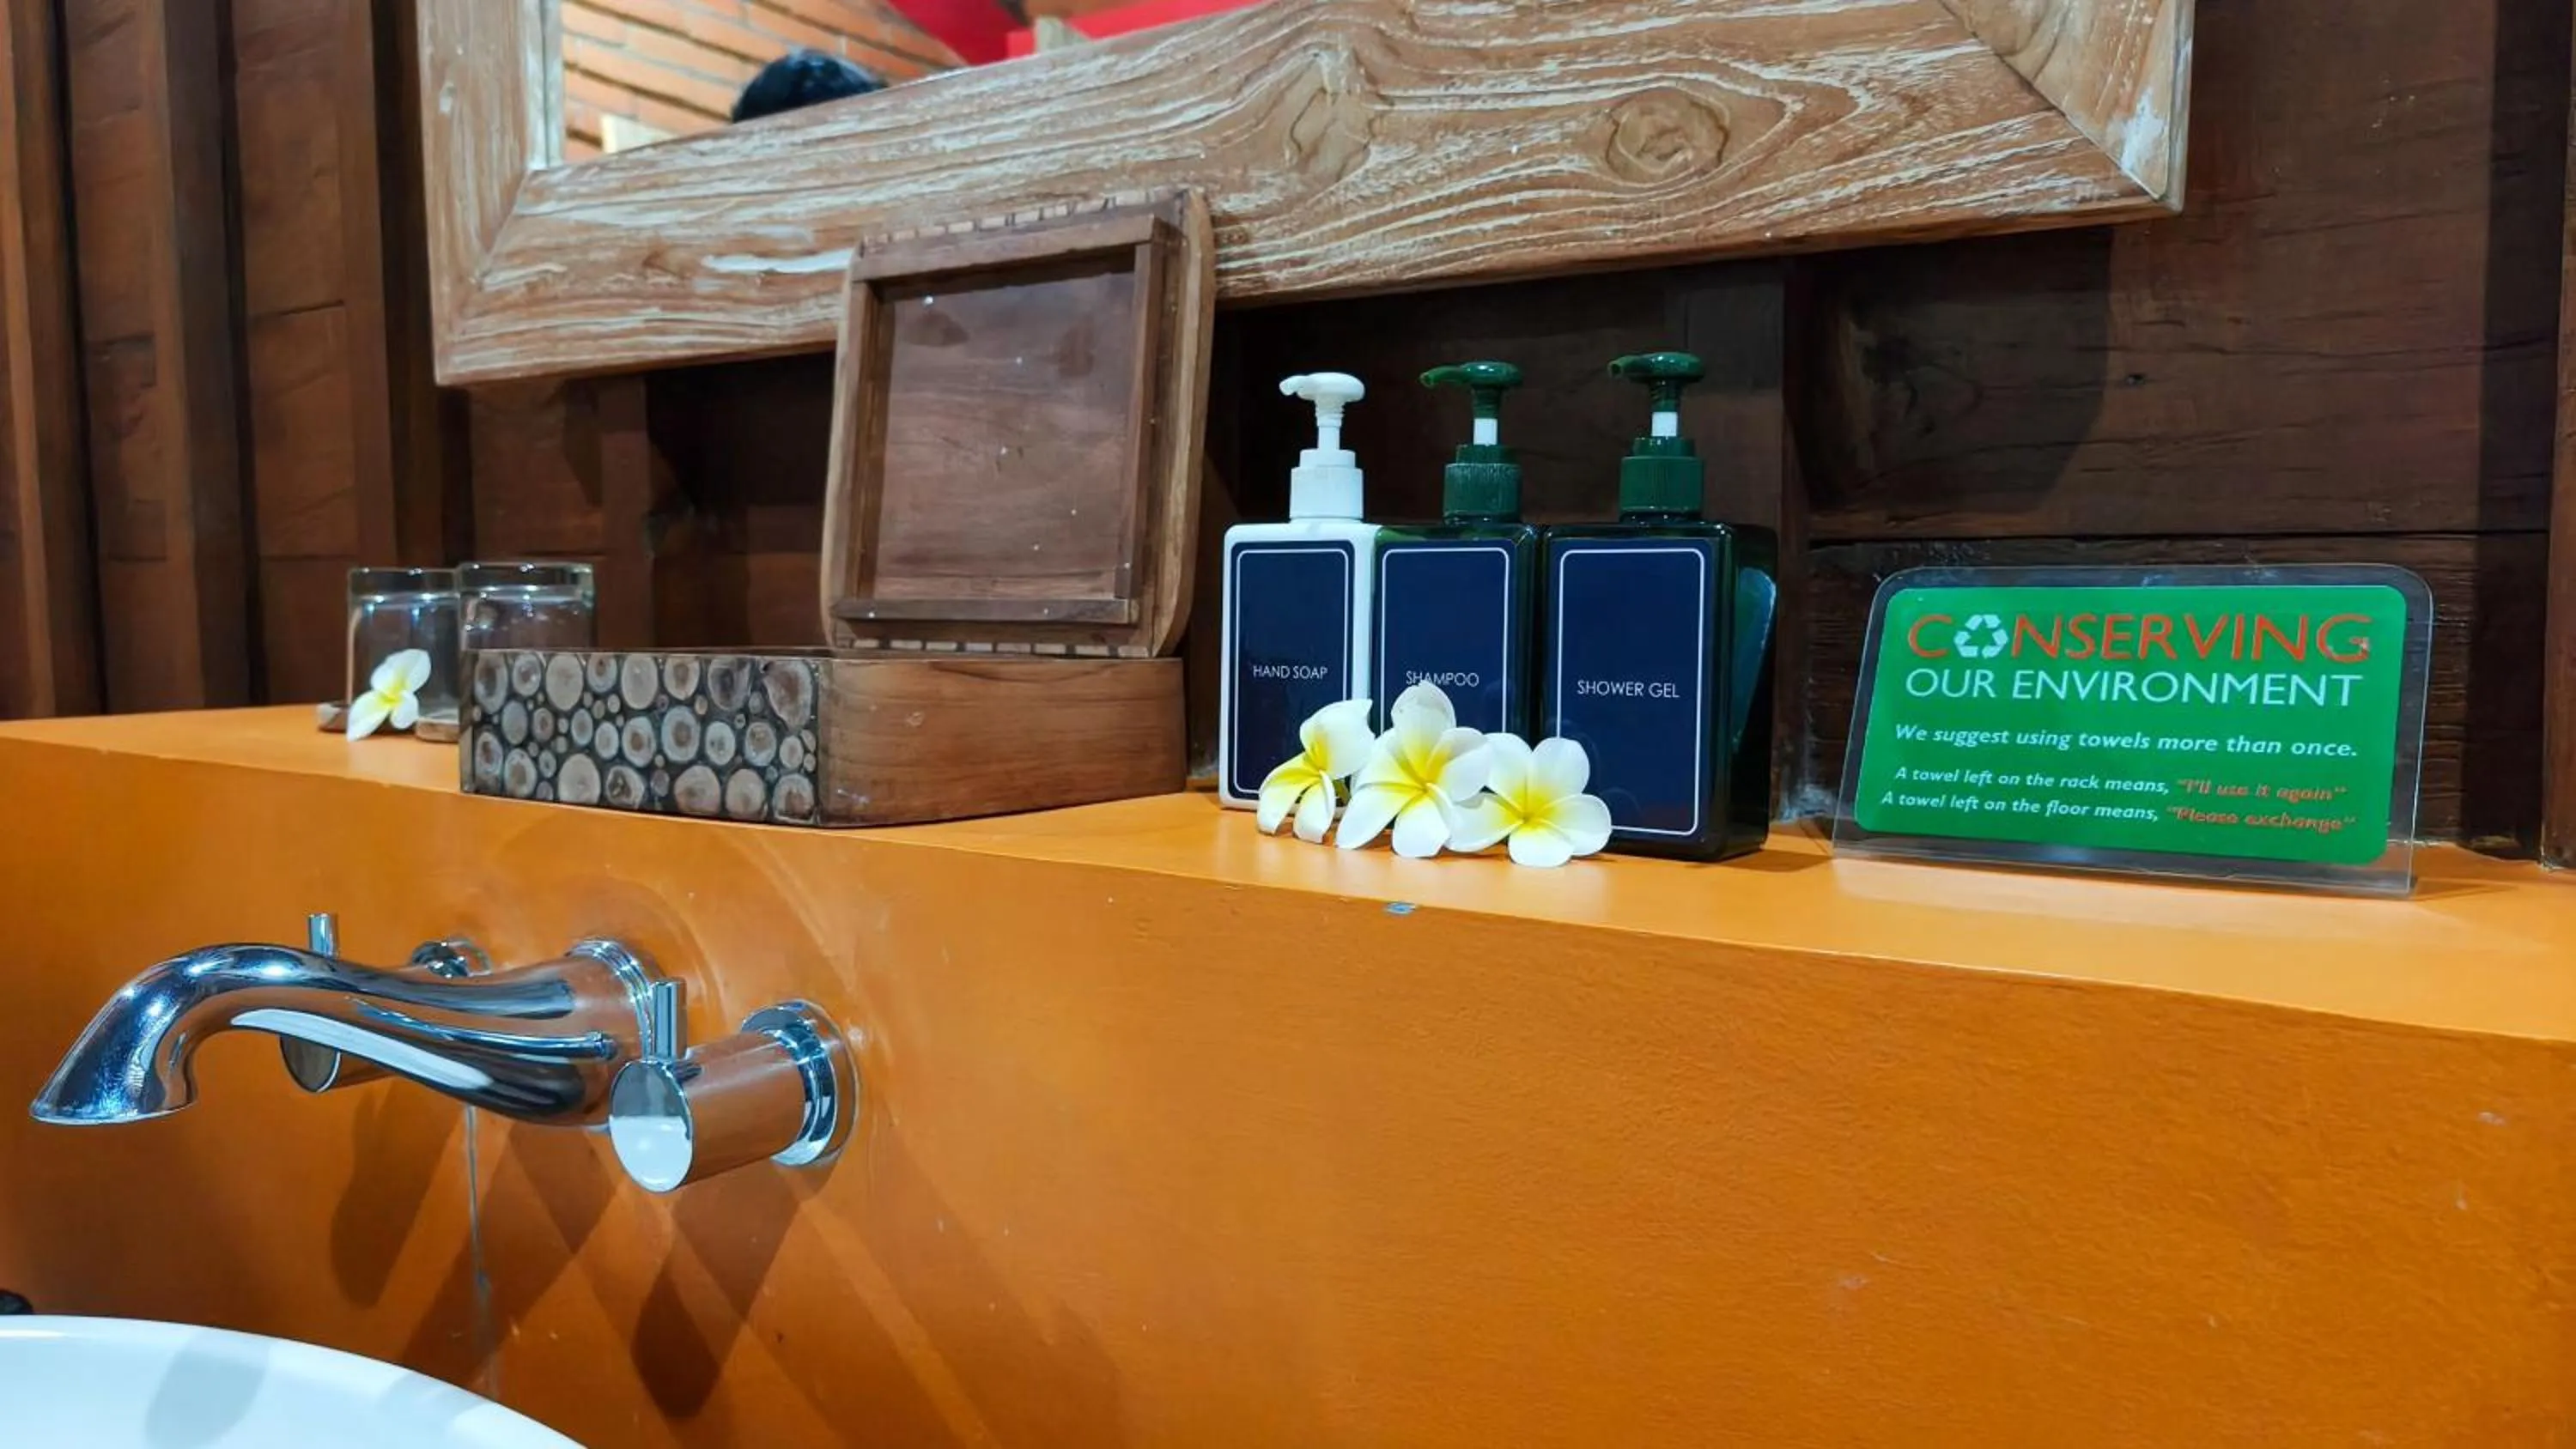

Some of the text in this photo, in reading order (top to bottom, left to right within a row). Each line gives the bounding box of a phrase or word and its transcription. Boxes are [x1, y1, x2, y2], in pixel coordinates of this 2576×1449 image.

[1906, 613, 2374, 664] CONSERVING
[1253, 665, 1328, 680] HAND SOAP
[1406, 670, 1479, 687] SHAMPOO
[1905, 668, 2365, 707] OUR ENVIRONMENT
[1577, 679, 1680, 699] SHOWER GEL
[1895, 724, 2358, 757] We suggest using towels more than once.
[1894, 767, 1907, 779] A
[1911, 769, 1960, 782] towel
[1964, 770, 1993, 787] left
[1997, 775, 2020, 786] on
[2025, 773, 2056, 787] the
[2058, 775, 2100, 790] rack
[2104, 779, 2170, 795] means,
[2216, 785, 2250, 797] use
[2254, 785, 2271, 797] it
[1881, 791, 1894, 805] A
[1898, 794, 1947, 808] towel
[1949, 795, 1979, 813] left
[1983, 801, 2007, 811] on
[2011, 799, 2042, 814] the
[2044, 799, 2091, 817] floor
[2093, 806, 2160, 822] means,
